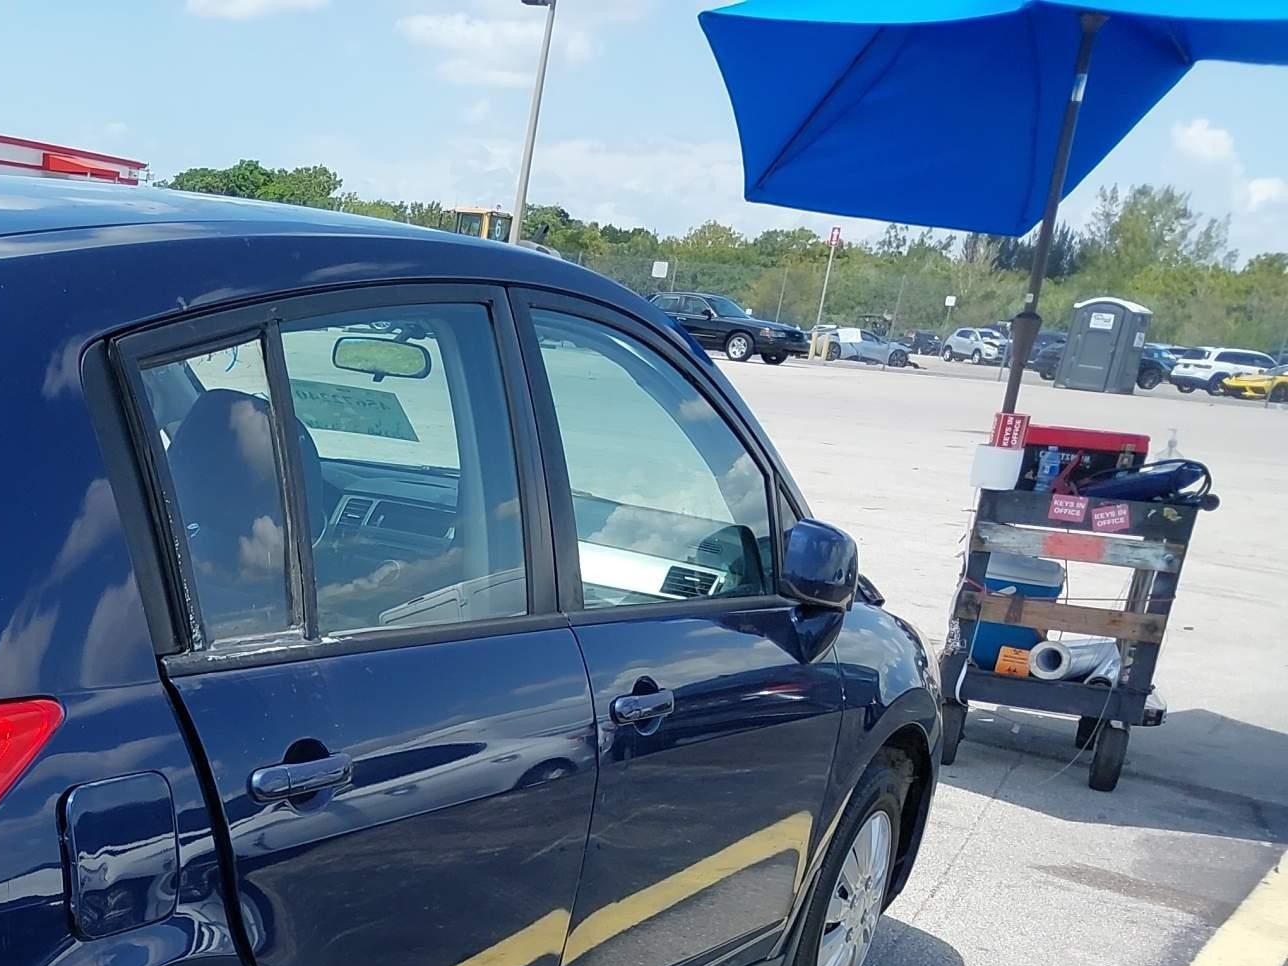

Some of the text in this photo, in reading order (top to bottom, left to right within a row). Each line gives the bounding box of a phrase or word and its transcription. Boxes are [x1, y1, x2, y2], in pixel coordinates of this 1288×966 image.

[495, 219, 502, 238] 6
[1002, 416, 1014, 447] KEYS IN
[1011, 419, 1022, 445] OFFICE
[1053, 500, 1073, 508] KEYS
[1053, 507, 1081, 516] OFFICE
[1094, 511, 1116, 520] KEYS
[1096, 517, 1125, 527] OFFICE
